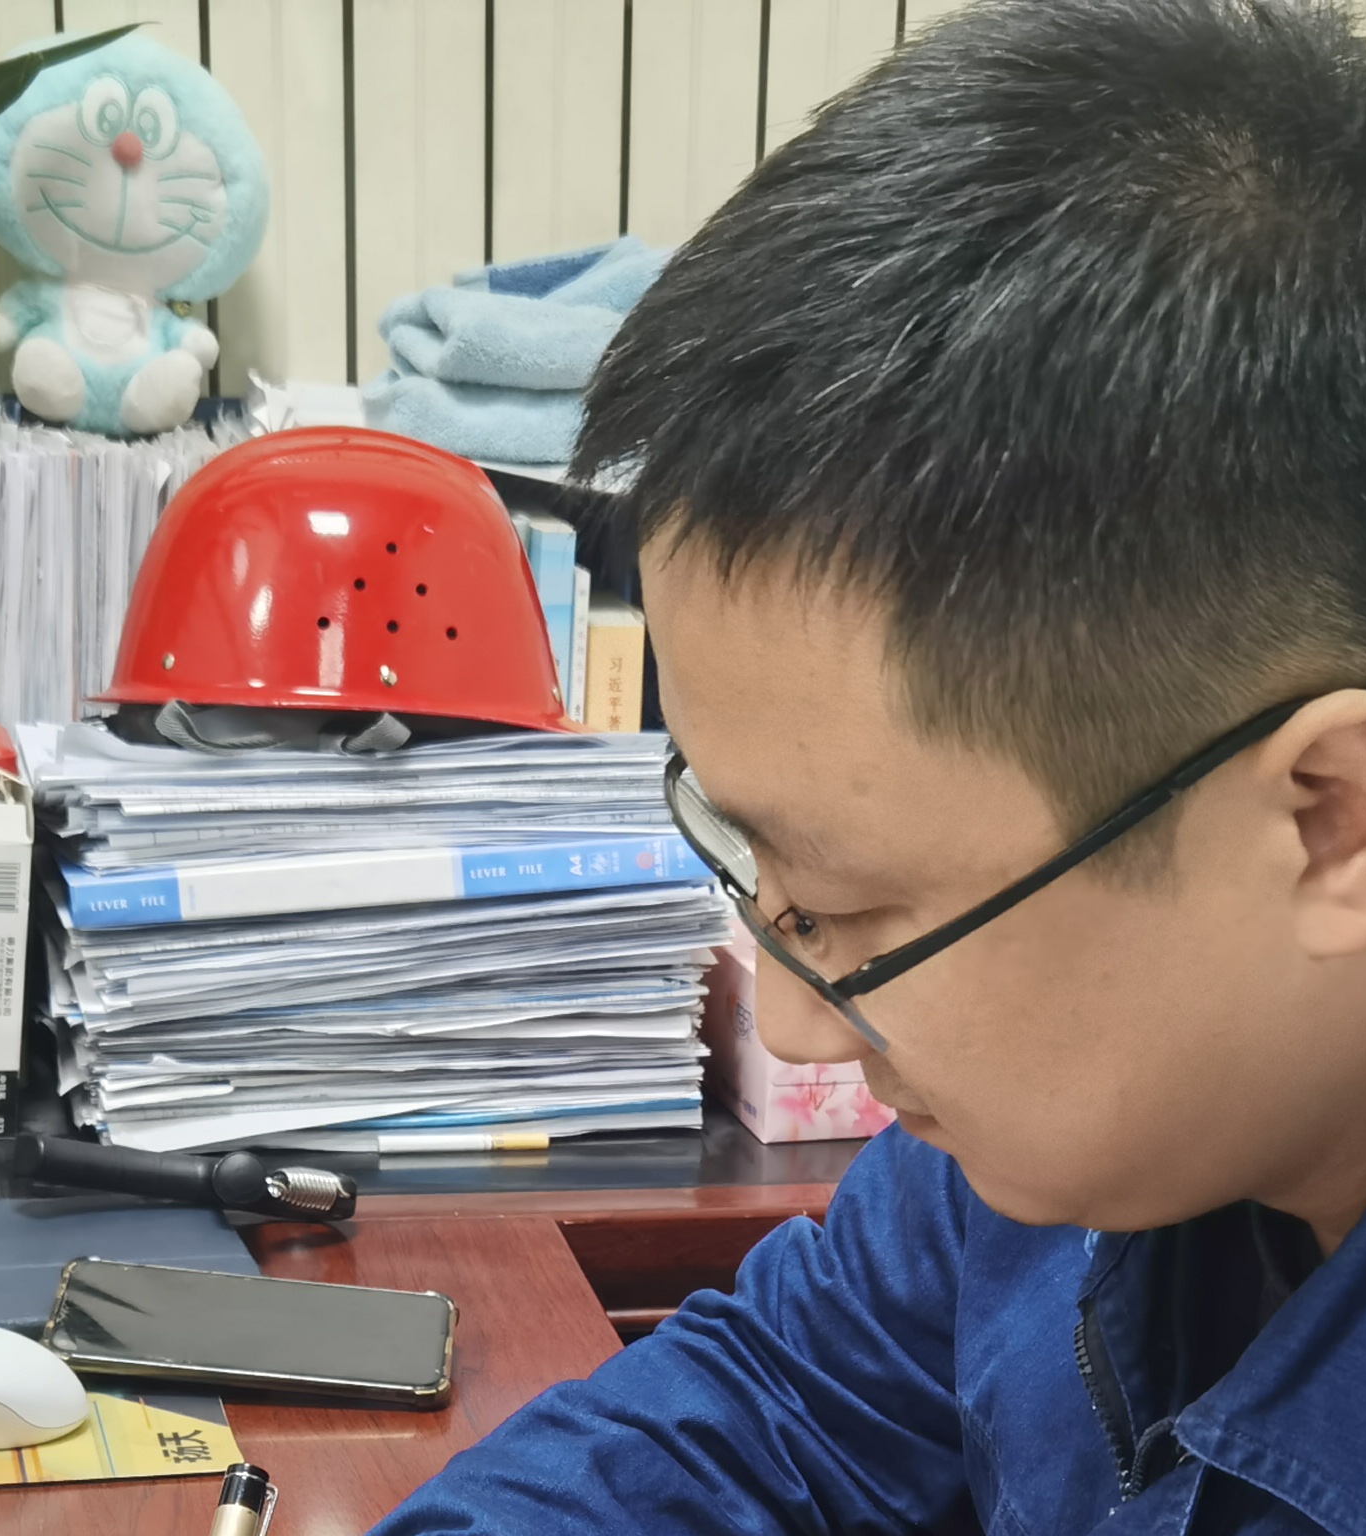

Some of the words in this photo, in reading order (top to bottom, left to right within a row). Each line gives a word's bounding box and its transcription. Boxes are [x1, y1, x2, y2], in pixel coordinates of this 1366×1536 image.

[470, 865, 506, 879] LEVER
[518, 864, 543, 875] FILE
[568, 854, 583, 876] A4
[90, 898, 128, 912] LEVER
[140, 895, 167, 909] FILE
